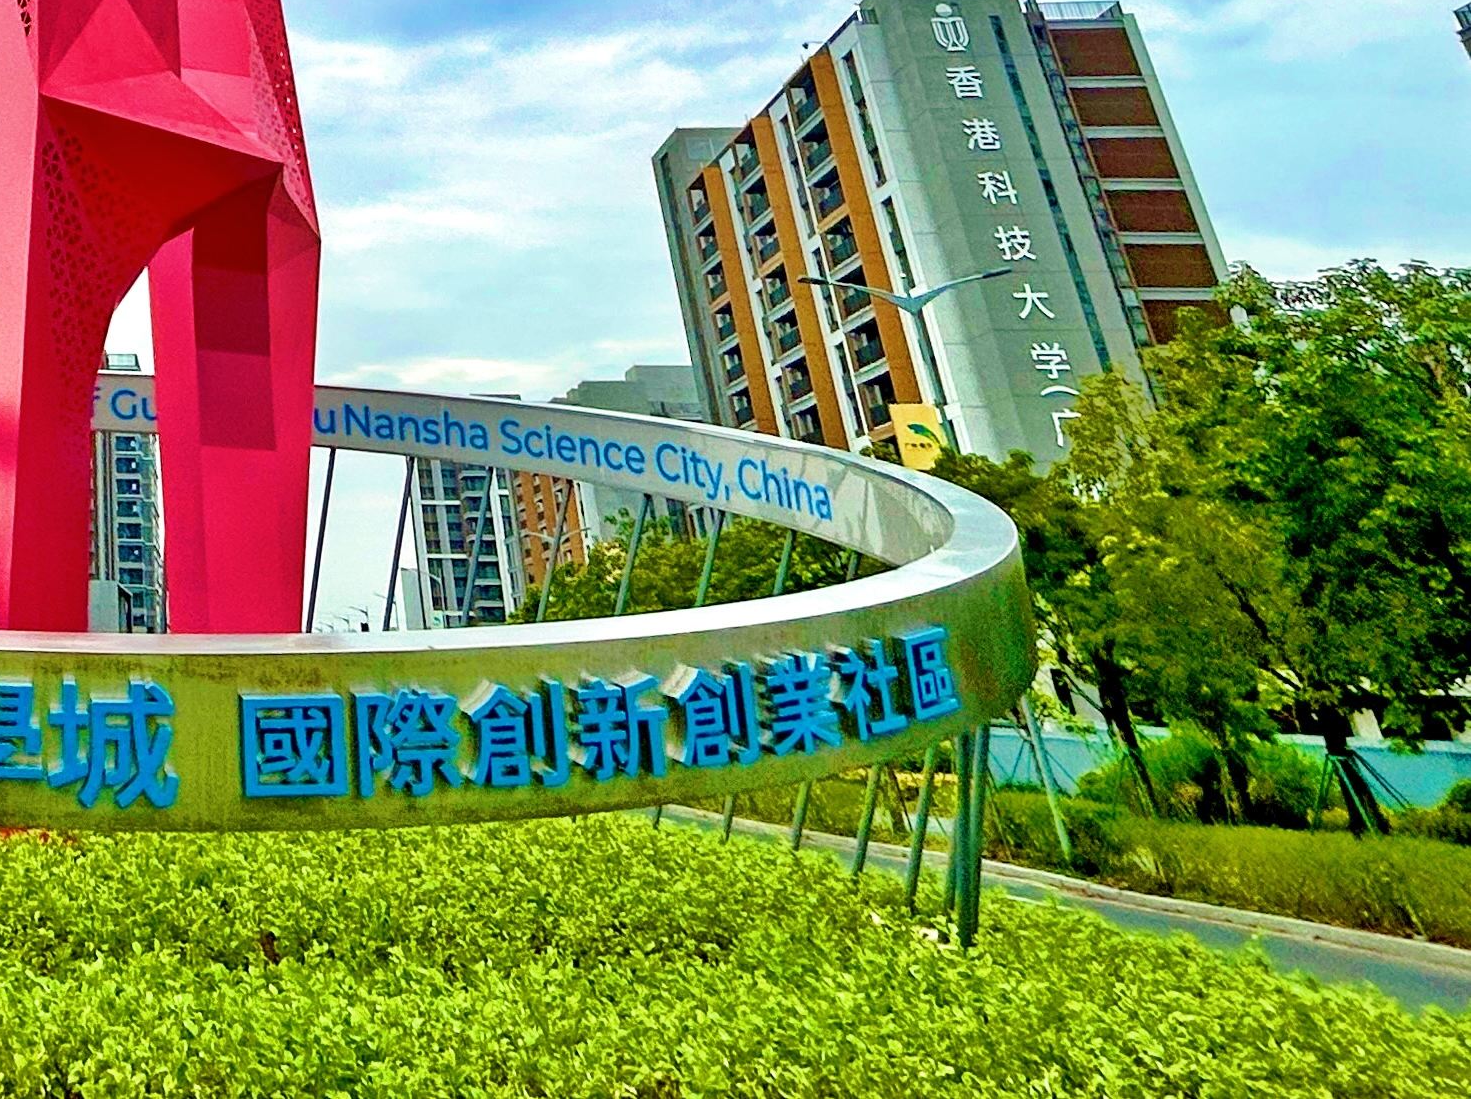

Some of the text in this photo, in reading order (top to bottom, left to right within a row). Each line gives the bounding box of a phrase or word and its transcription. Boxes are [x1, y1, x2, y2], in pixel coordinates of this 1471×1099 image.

[343, 403, 489, 451] Nansha
[499, 419, 646, 475] Science
[655, 443, 730, 502] City,
[736, 458, 833, 522] China
[239, 622, 963, 798] 國際創新創業社區
